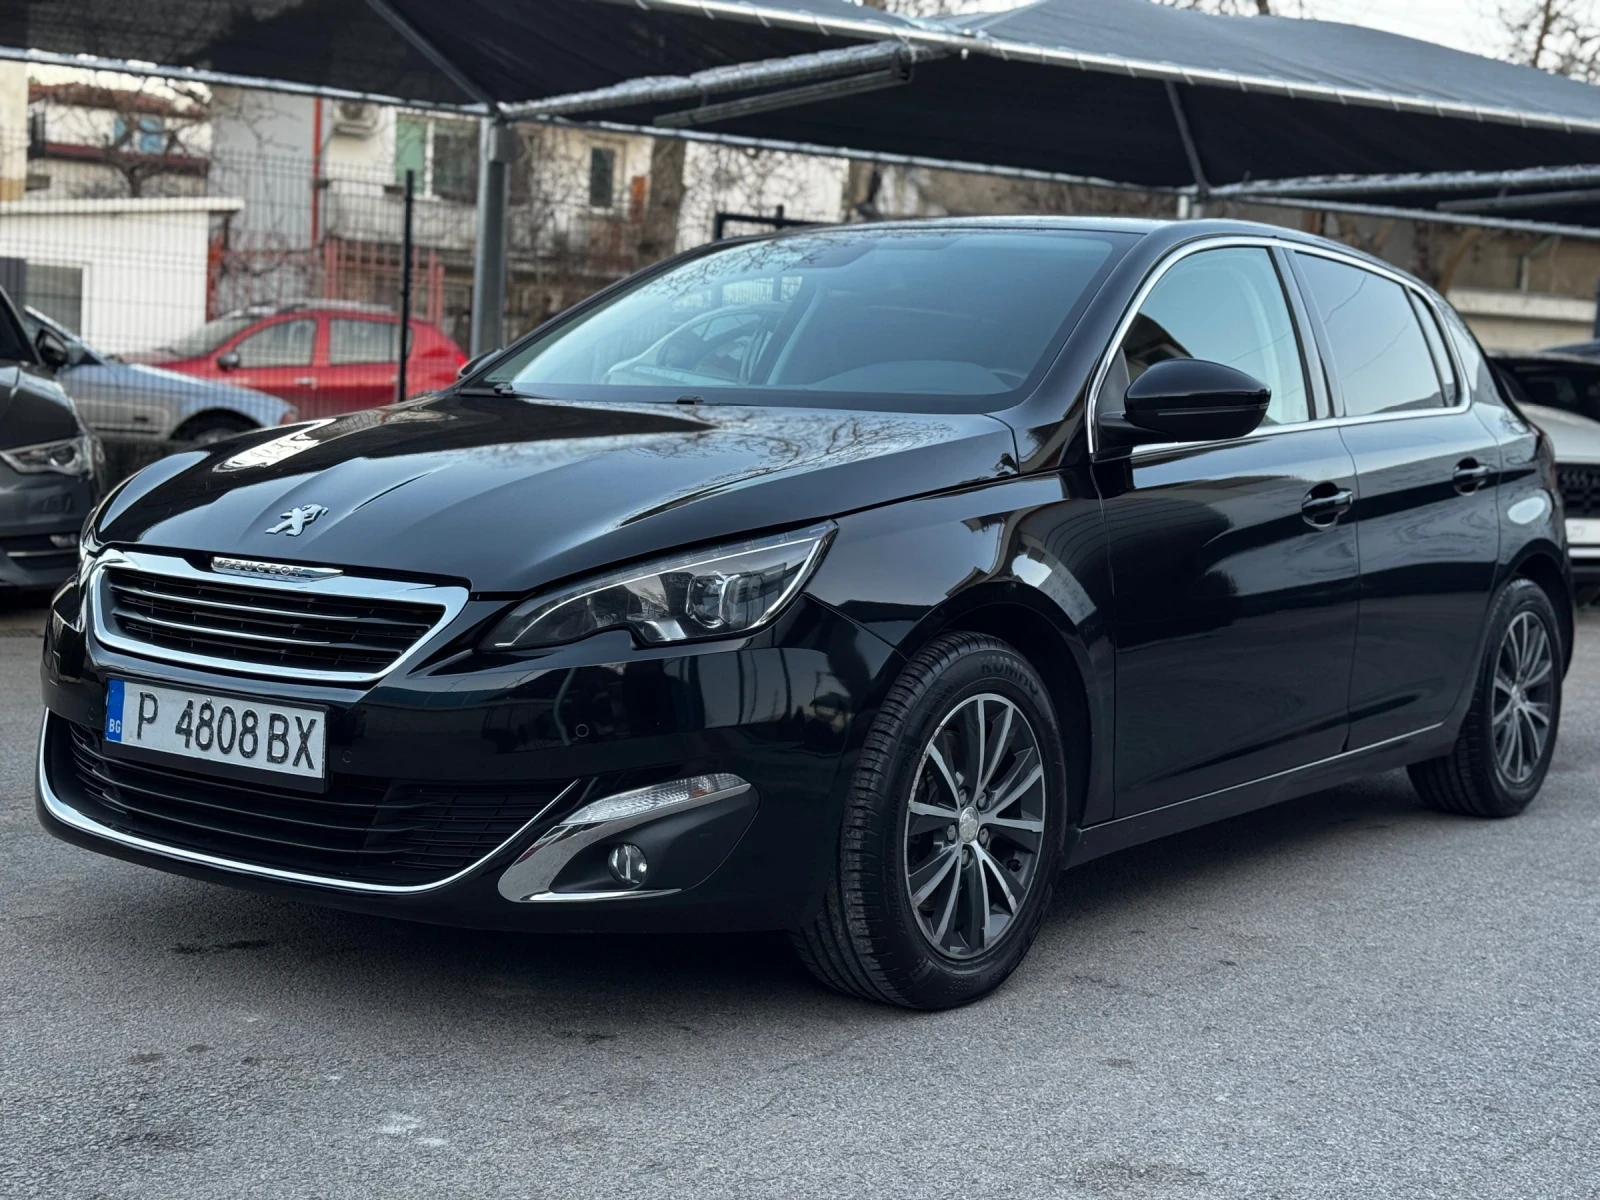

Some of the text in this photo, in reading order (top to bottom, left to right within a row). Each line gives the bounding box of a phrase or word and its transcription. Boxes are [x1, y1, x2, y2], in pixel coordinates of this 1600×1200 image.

[223, 559, 302, 577] PEUGEOT
[108, 718, 121, 734] BG
[137, 691, 318, 770] P 4808 BX
